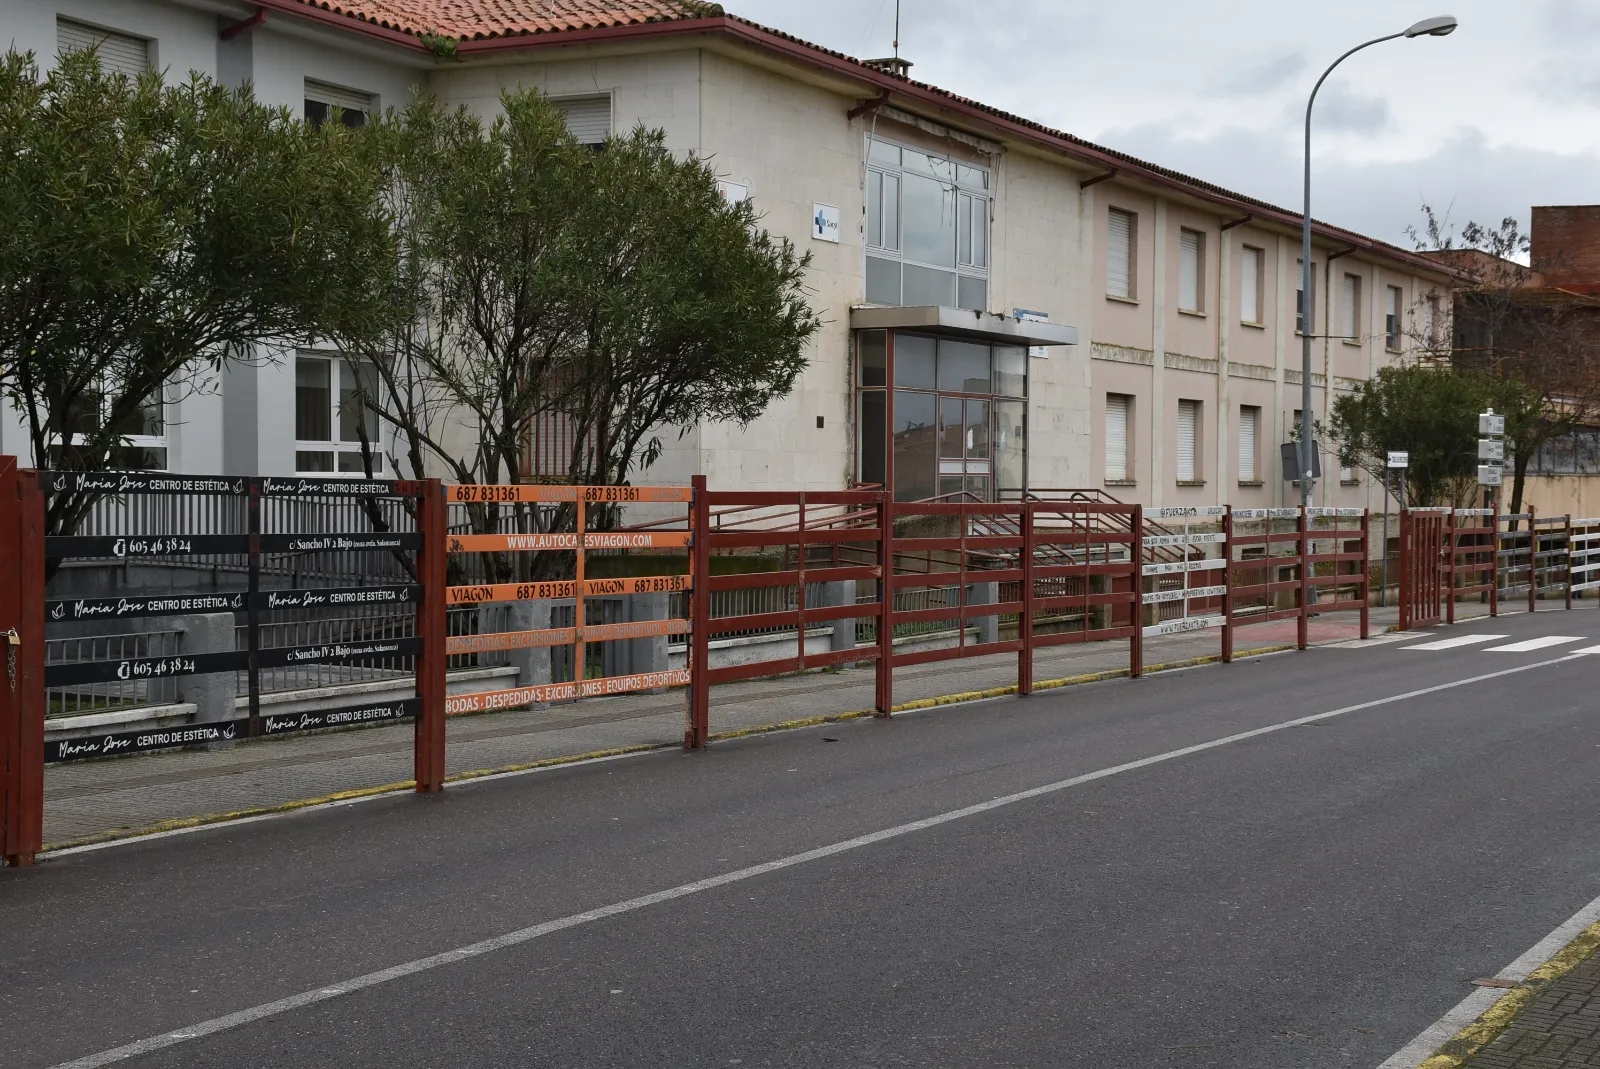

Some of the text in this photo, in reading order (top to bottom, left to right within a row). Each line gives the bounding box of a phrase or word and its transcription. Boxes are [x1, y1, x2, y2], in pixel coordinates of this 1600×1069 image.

[150, 480, 181, 490] CENTRO
[182, 480, 192, 490] DE
[194, 478, 230, 491] ESTÉTICA
[322, 484, 349, 492] CENTRO
[350, 484, 358, 493] DE
[360, 482, 389, 493] ESTÉTICA
[456, 486, 477, 500] 687
[480, 486, 520, 500] 831361
[586, 488, 603, 500] 687
[606, 488, 639, 500] 831361
[129, 538, 191, 554] 605 46 38 24
[297, 538, 322, 549] Sancho
[323, 538, 332, 548] IV
[338, 538, 352, 550] Bajo
[508, 535, 652, 548] WWW.AUTOCAESVIAGON.COM
[452, 582, 575, 601] VIAGON 687 831361
[589, 578, 685, 594] VIAGON 687 831361
[330, 593, 356, 602] CENTRO
[357, 592, 366, 601] DE
[367, 589, 395, 600] ESTÉTICA
[148, 600, 179, 611] CENTRO
[181, 599, 191, 609] DE
[193, 596, 228, 608] ESTÉTICA
[295, 649, 320, 660] Sancho
[321, 647, 330, 657] IV
[336, 646, 350, 658] Bajo
[133, 658, 195, 676] 605 46 38 24
[485, 689, 541, 708] DESPEDIDAS
[607, 676, 641, 692] EQUIPOS
[643, 670, 690, 687] DEPORTIVOS
[326, 713, 352, 724] CENTRO
[354, 711, 362, 720] DE
[363, 707, 391, 719] ESTÉTICA
[137, 735, 170, 747] CENTRO
[171, 734, 182, 745] DE
[184, 727, 219, 743] ESTÉTICA
